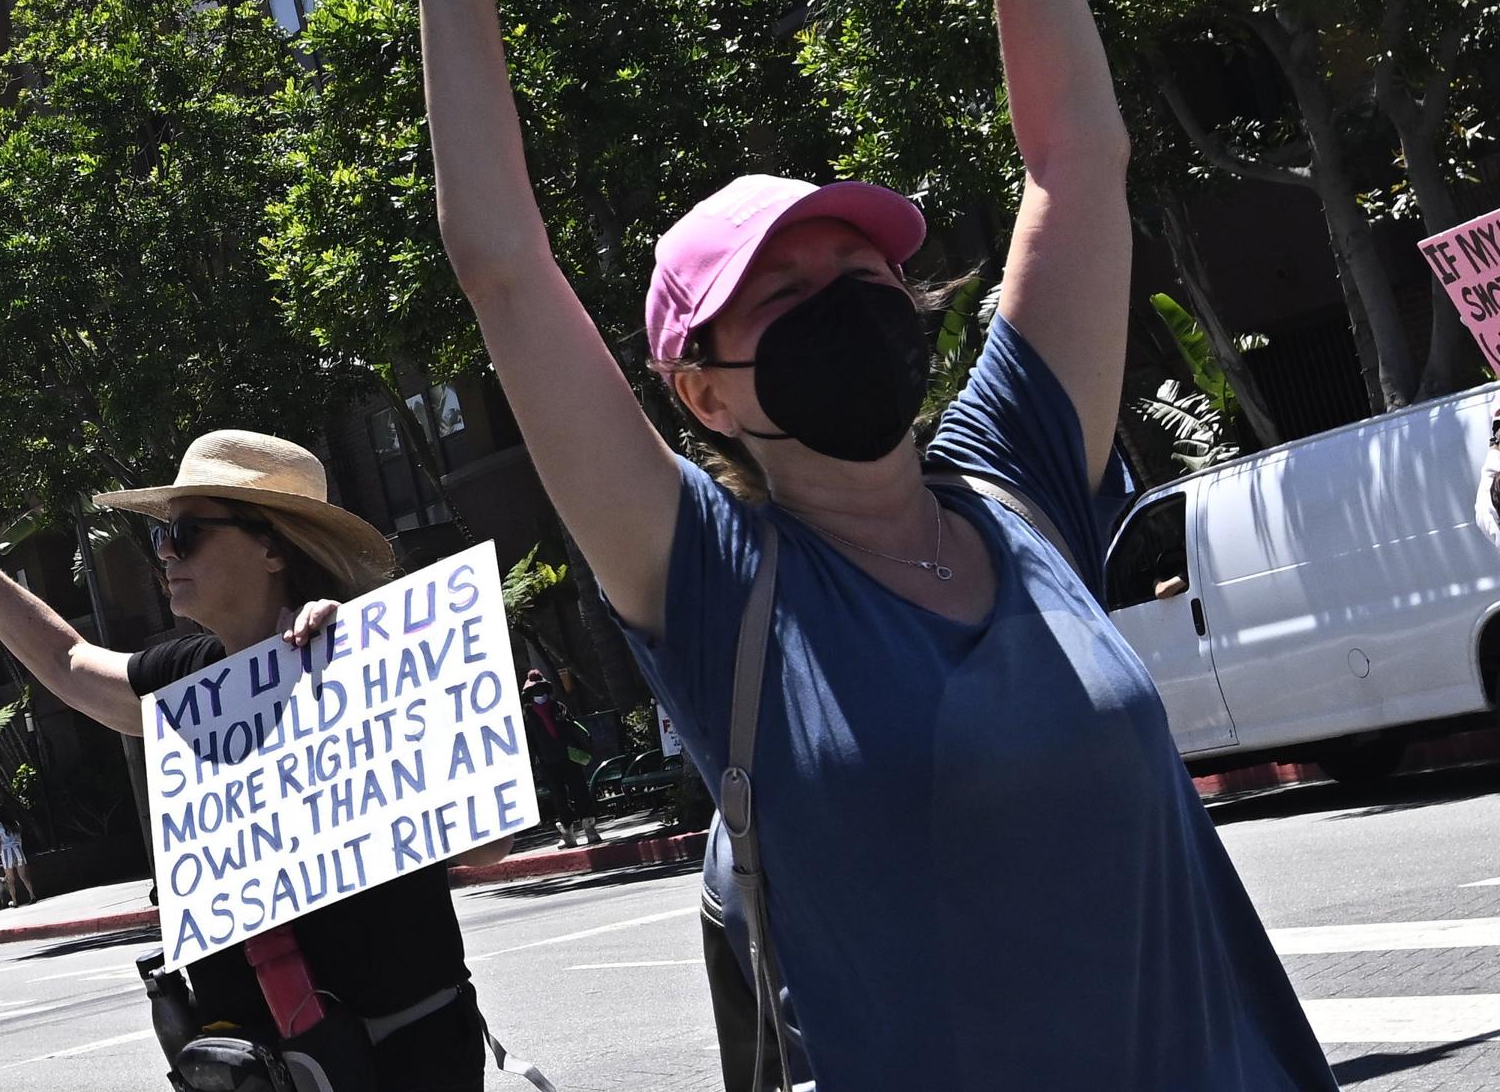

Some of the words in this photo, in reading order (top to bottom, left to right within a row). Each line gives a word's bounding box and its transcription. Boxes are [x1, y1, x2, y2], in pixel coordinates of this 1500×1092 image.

[1422, 241, 1461, 285] IF
[156, 668, 231, 740] MY
[250, 564, 480, 697] UTERUS
[161, 680, 348, 797] SHOULD
[363, 616, 487, 709] HAVE
[161, 770, 266, 852] MORE
[276, 698, 427, 799] RIGHTS
[445, 670, 503, 723] TO
[171, 813, 299, 897] OWN,
[303, 749, 427, 836] THAN
[447, 715, 520, 781] AN
[172, 832, 372, 962] ASSAULT
[392, 779, 525, 871] RIFLE
